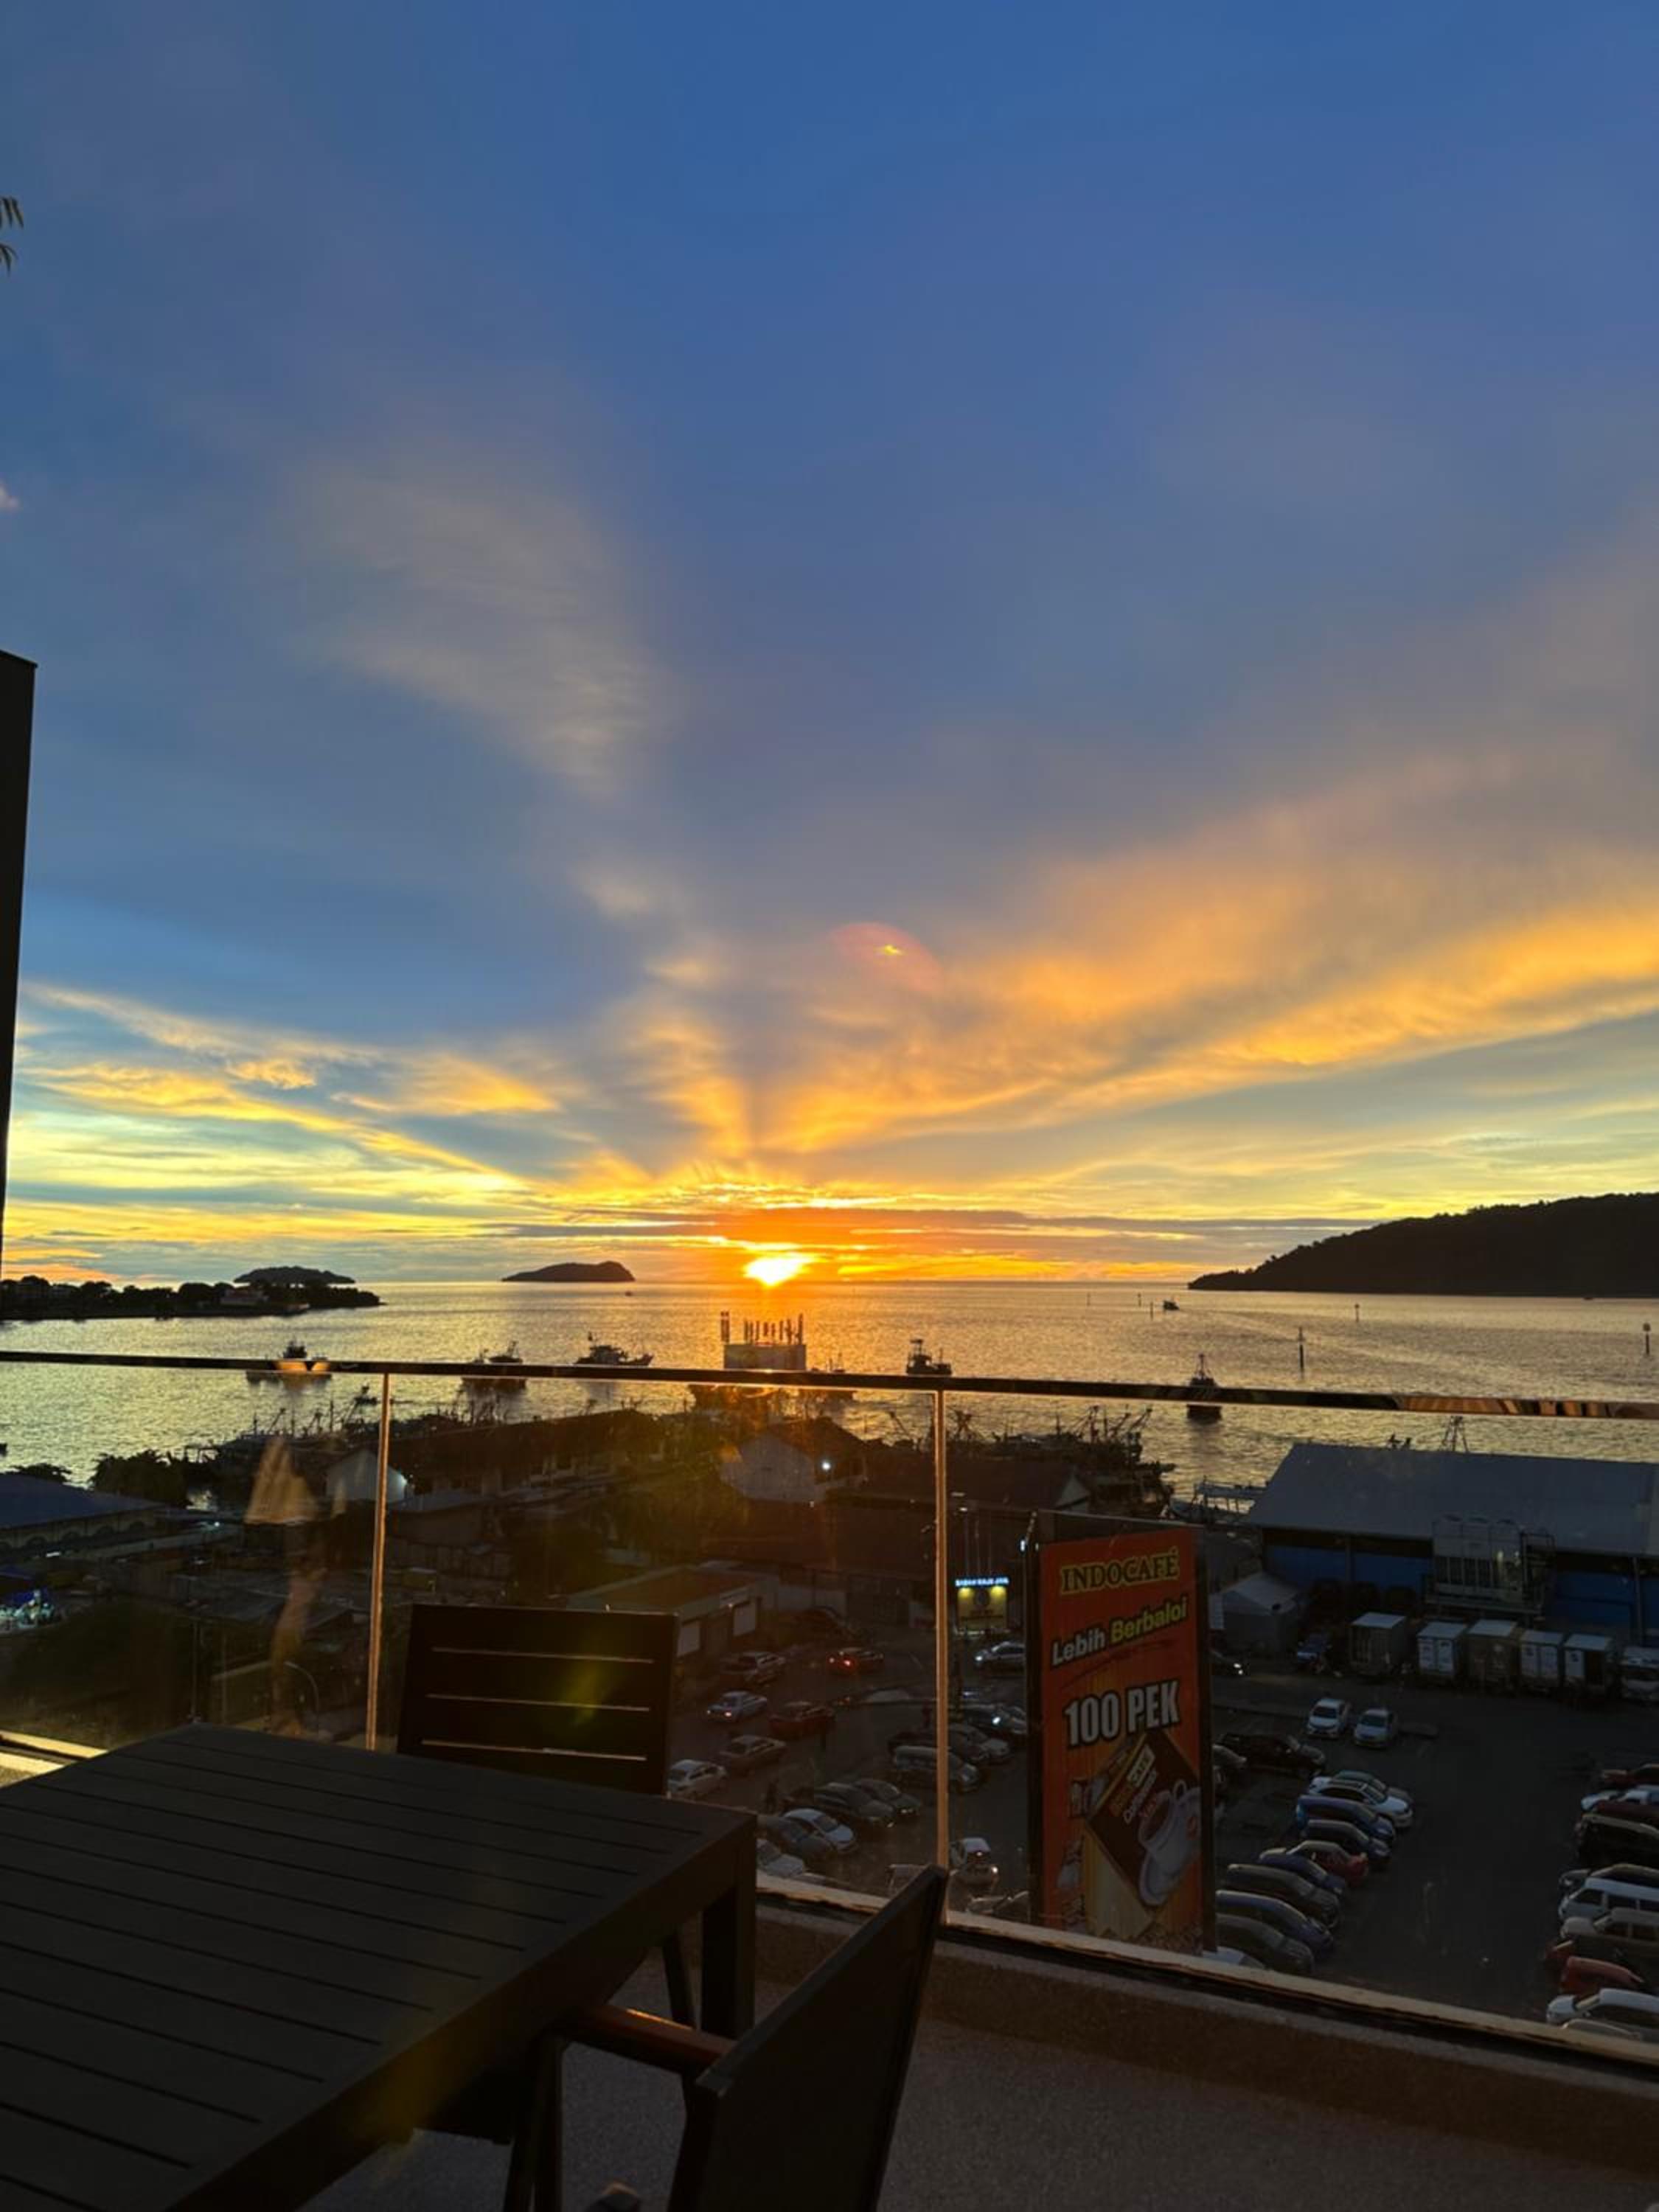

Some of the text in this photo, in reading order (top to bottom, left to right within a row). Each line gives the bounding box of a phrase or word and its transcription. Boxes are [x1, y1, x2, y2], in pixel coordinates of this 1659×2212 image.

[1061, 1546, 1180, 1596] INDOCAFÉ
[1051, 1596, 1188, 1667] Lebih Berbaloi
[1064, 1680, 1180, 1747] 100 PEK
